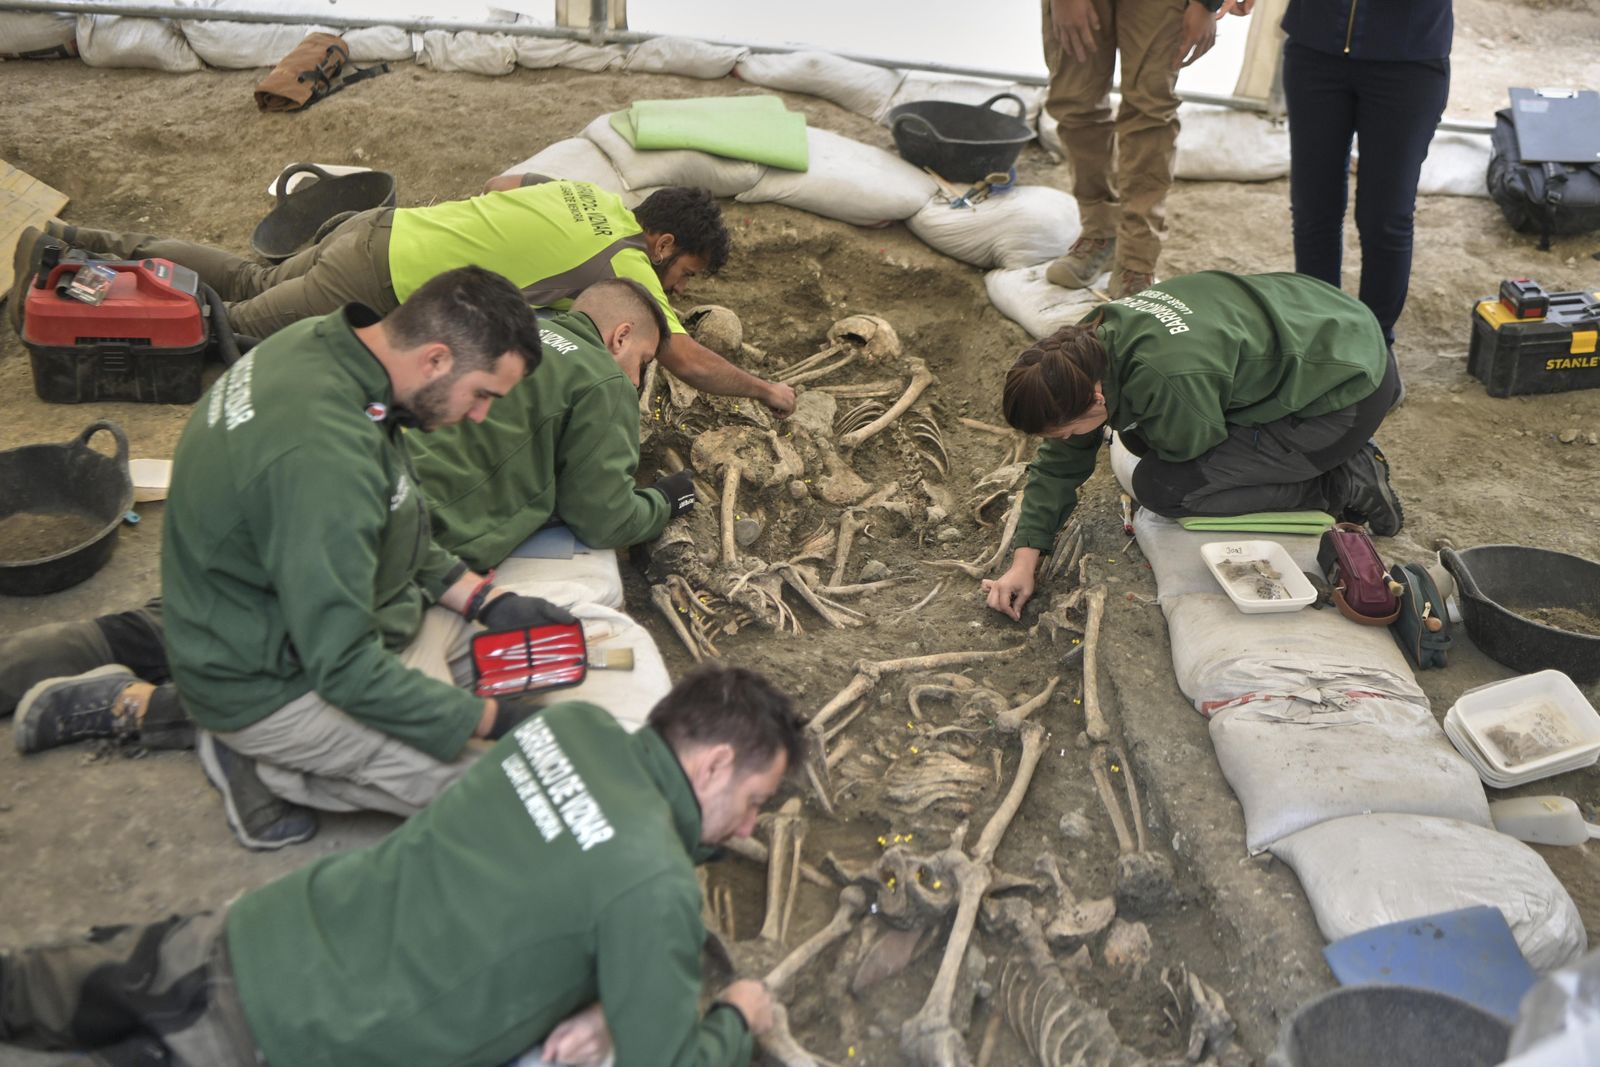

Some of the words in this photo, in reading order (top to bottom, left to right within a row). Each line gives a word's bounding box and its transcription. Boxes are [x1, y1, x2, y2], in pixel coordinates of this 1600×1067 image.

[1167, 298, 1194, 315] LUGAR
[1545, 357, 1600, 370] STANLE
[513, 715, 574, 787] BARRANCO
[547, 773, 585, 805] DE
